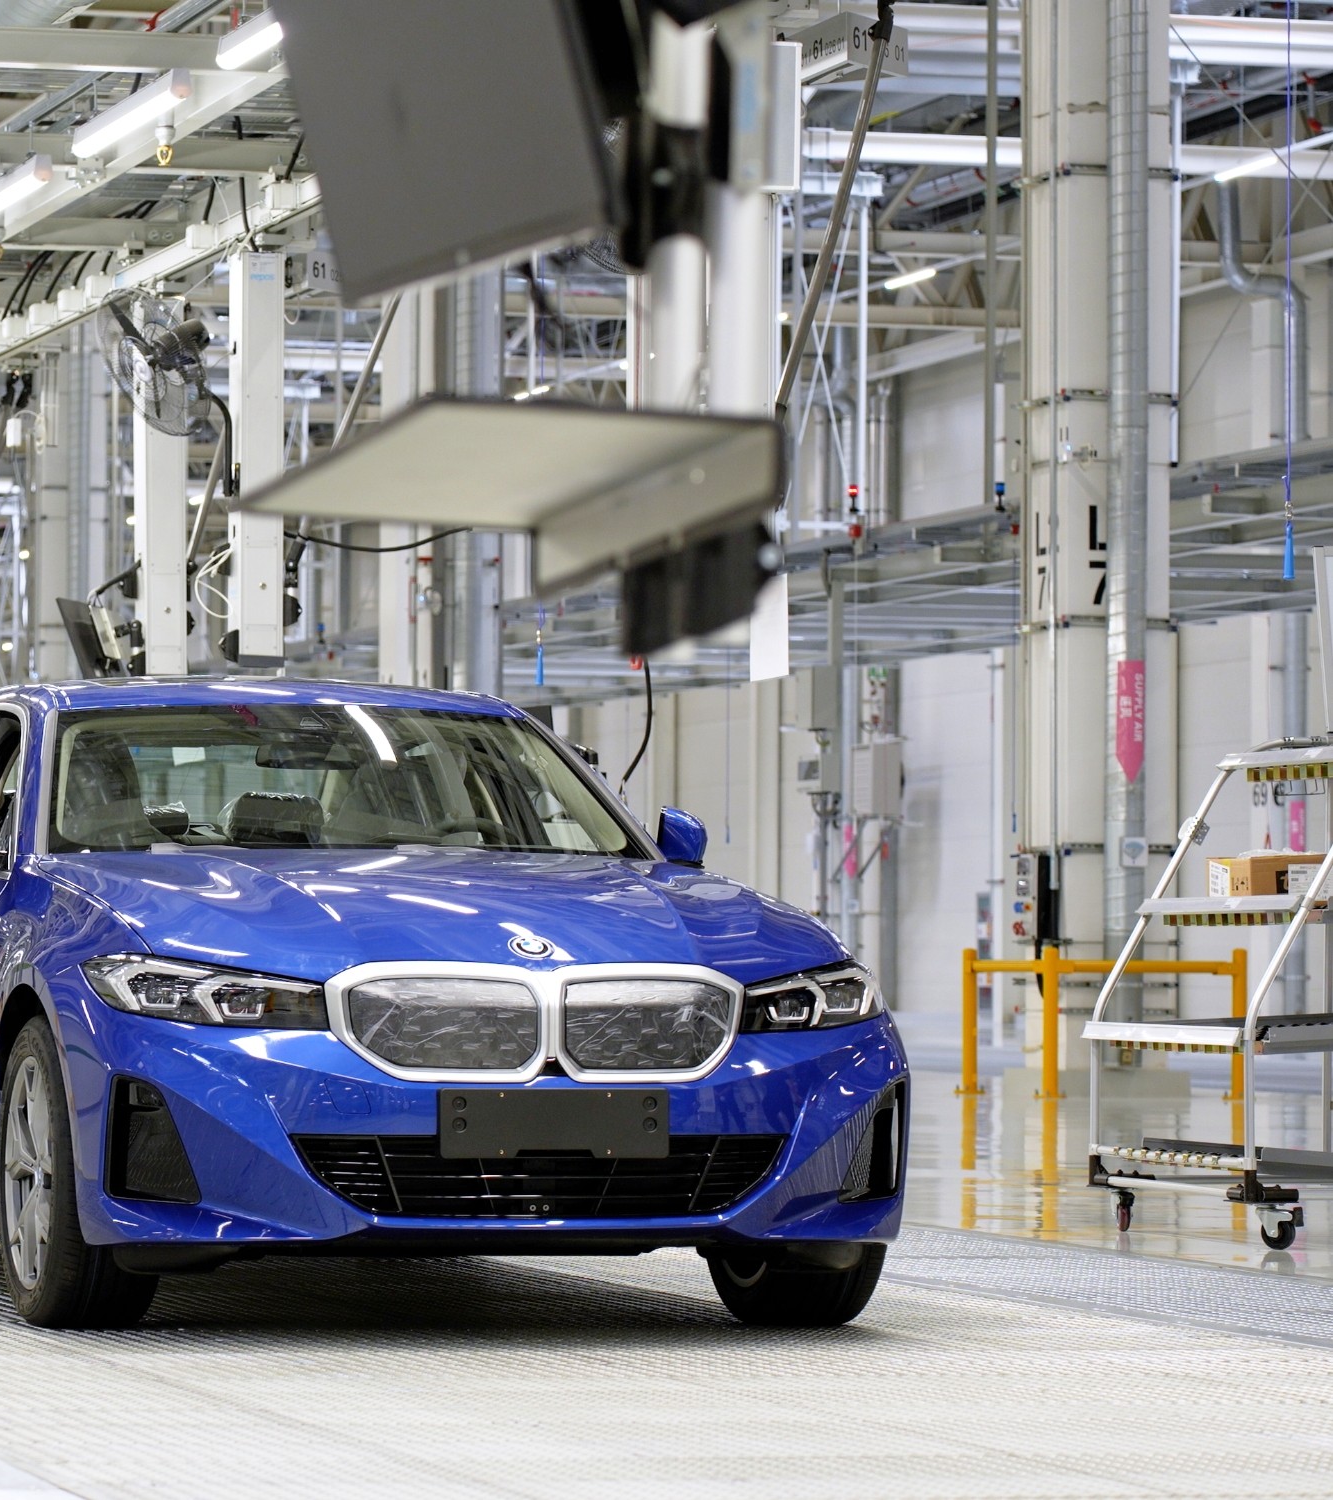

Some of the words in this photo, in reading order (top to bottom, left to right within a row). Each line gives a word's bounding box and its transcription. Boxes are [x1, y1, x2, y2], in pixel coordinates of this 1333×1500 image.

[813, 37, 823, 60] 61
[853, 26, 868, 52] 61
[895, 45, 905, 62] 01
[312, 261, 327, 279] 61
[1134, 673, 1144, 720] SUPPLY
[1133, 721, 1144, 742] AIR
[1253, 782, 1268, 808] 69
